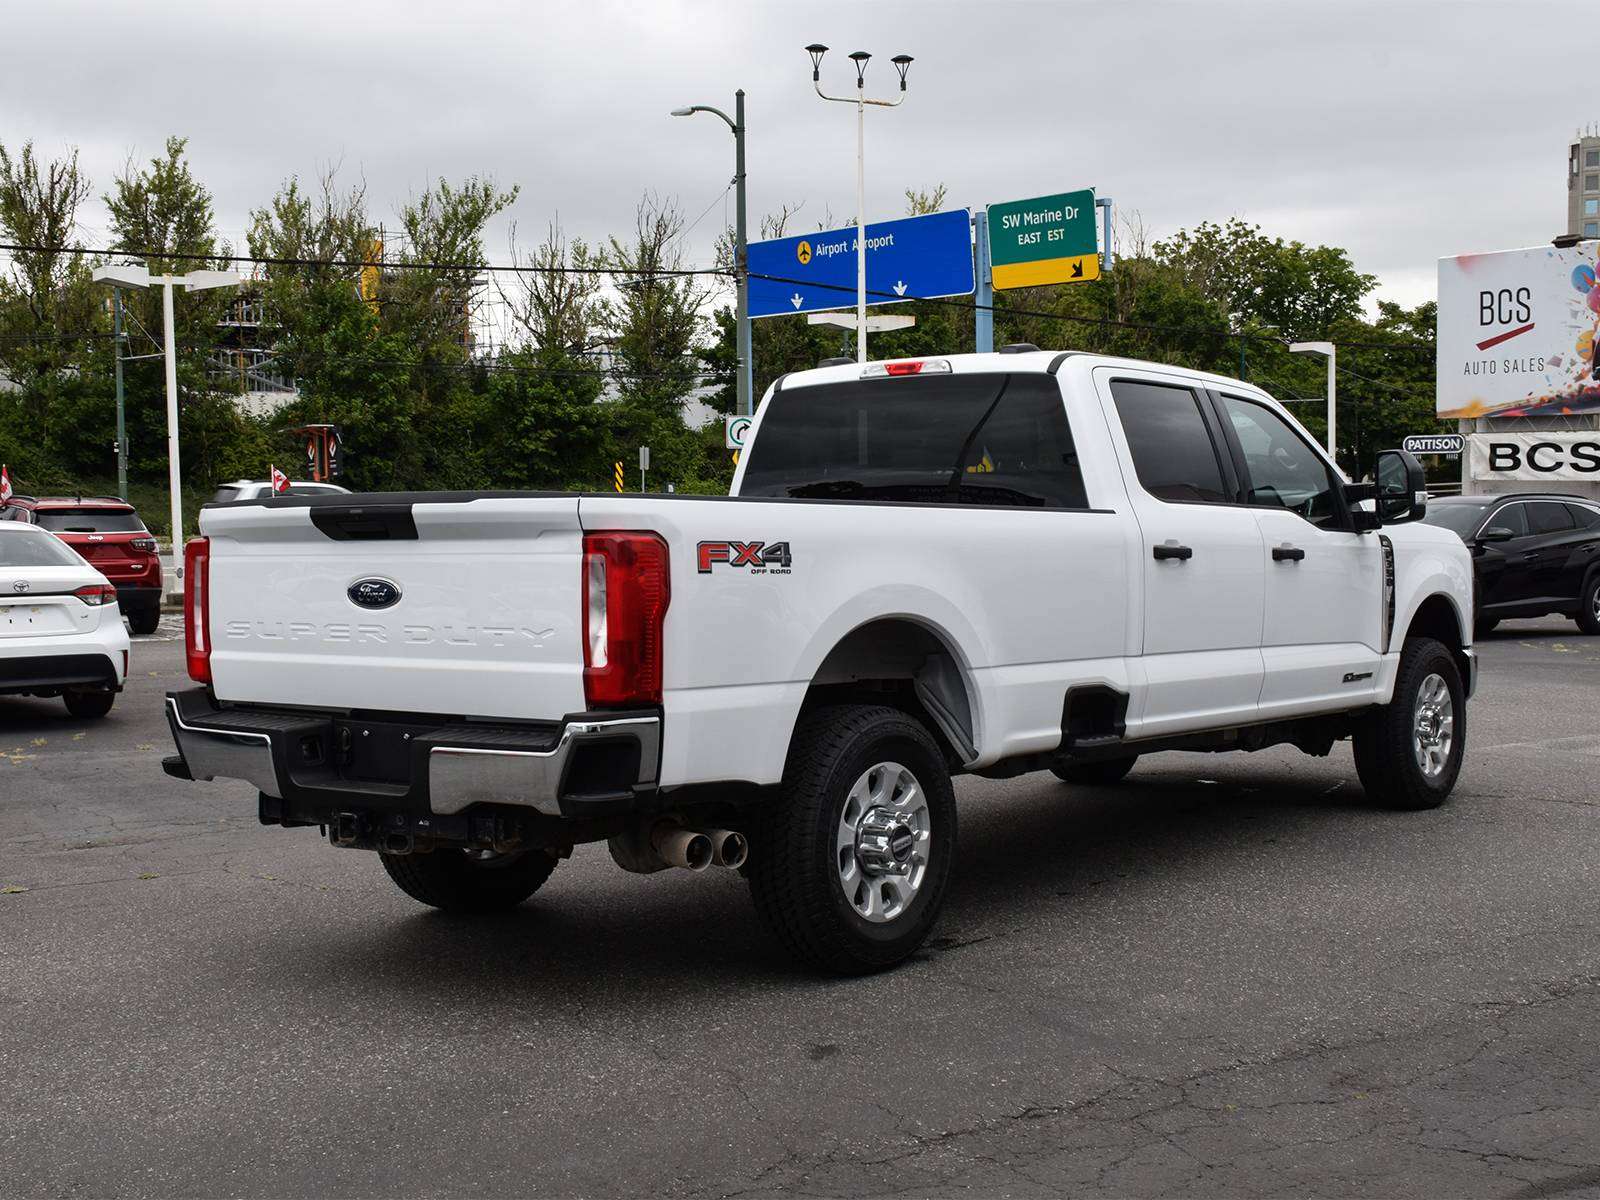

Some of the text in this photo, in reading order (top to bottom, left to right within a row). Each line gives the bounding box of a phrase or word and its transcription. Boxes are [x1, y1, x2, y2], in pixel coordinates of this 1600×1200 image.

[1002, 205, 1079, 229] SW Marine Dr
[816, 233, 894, 258] Airport Aroport
[1017, 228, 1065, 245] EAST EST
[1479, 287, 1531, 327] BCS
[1463, 357, 1545, 376] AUTO SALES
[1407, 438, 1461, 450] PATTISON
[1488, 441, 1600, 473] BCS
[696, 540, 792, 574] FX4
[226, 620, 556, 648] SUPER DUTY
